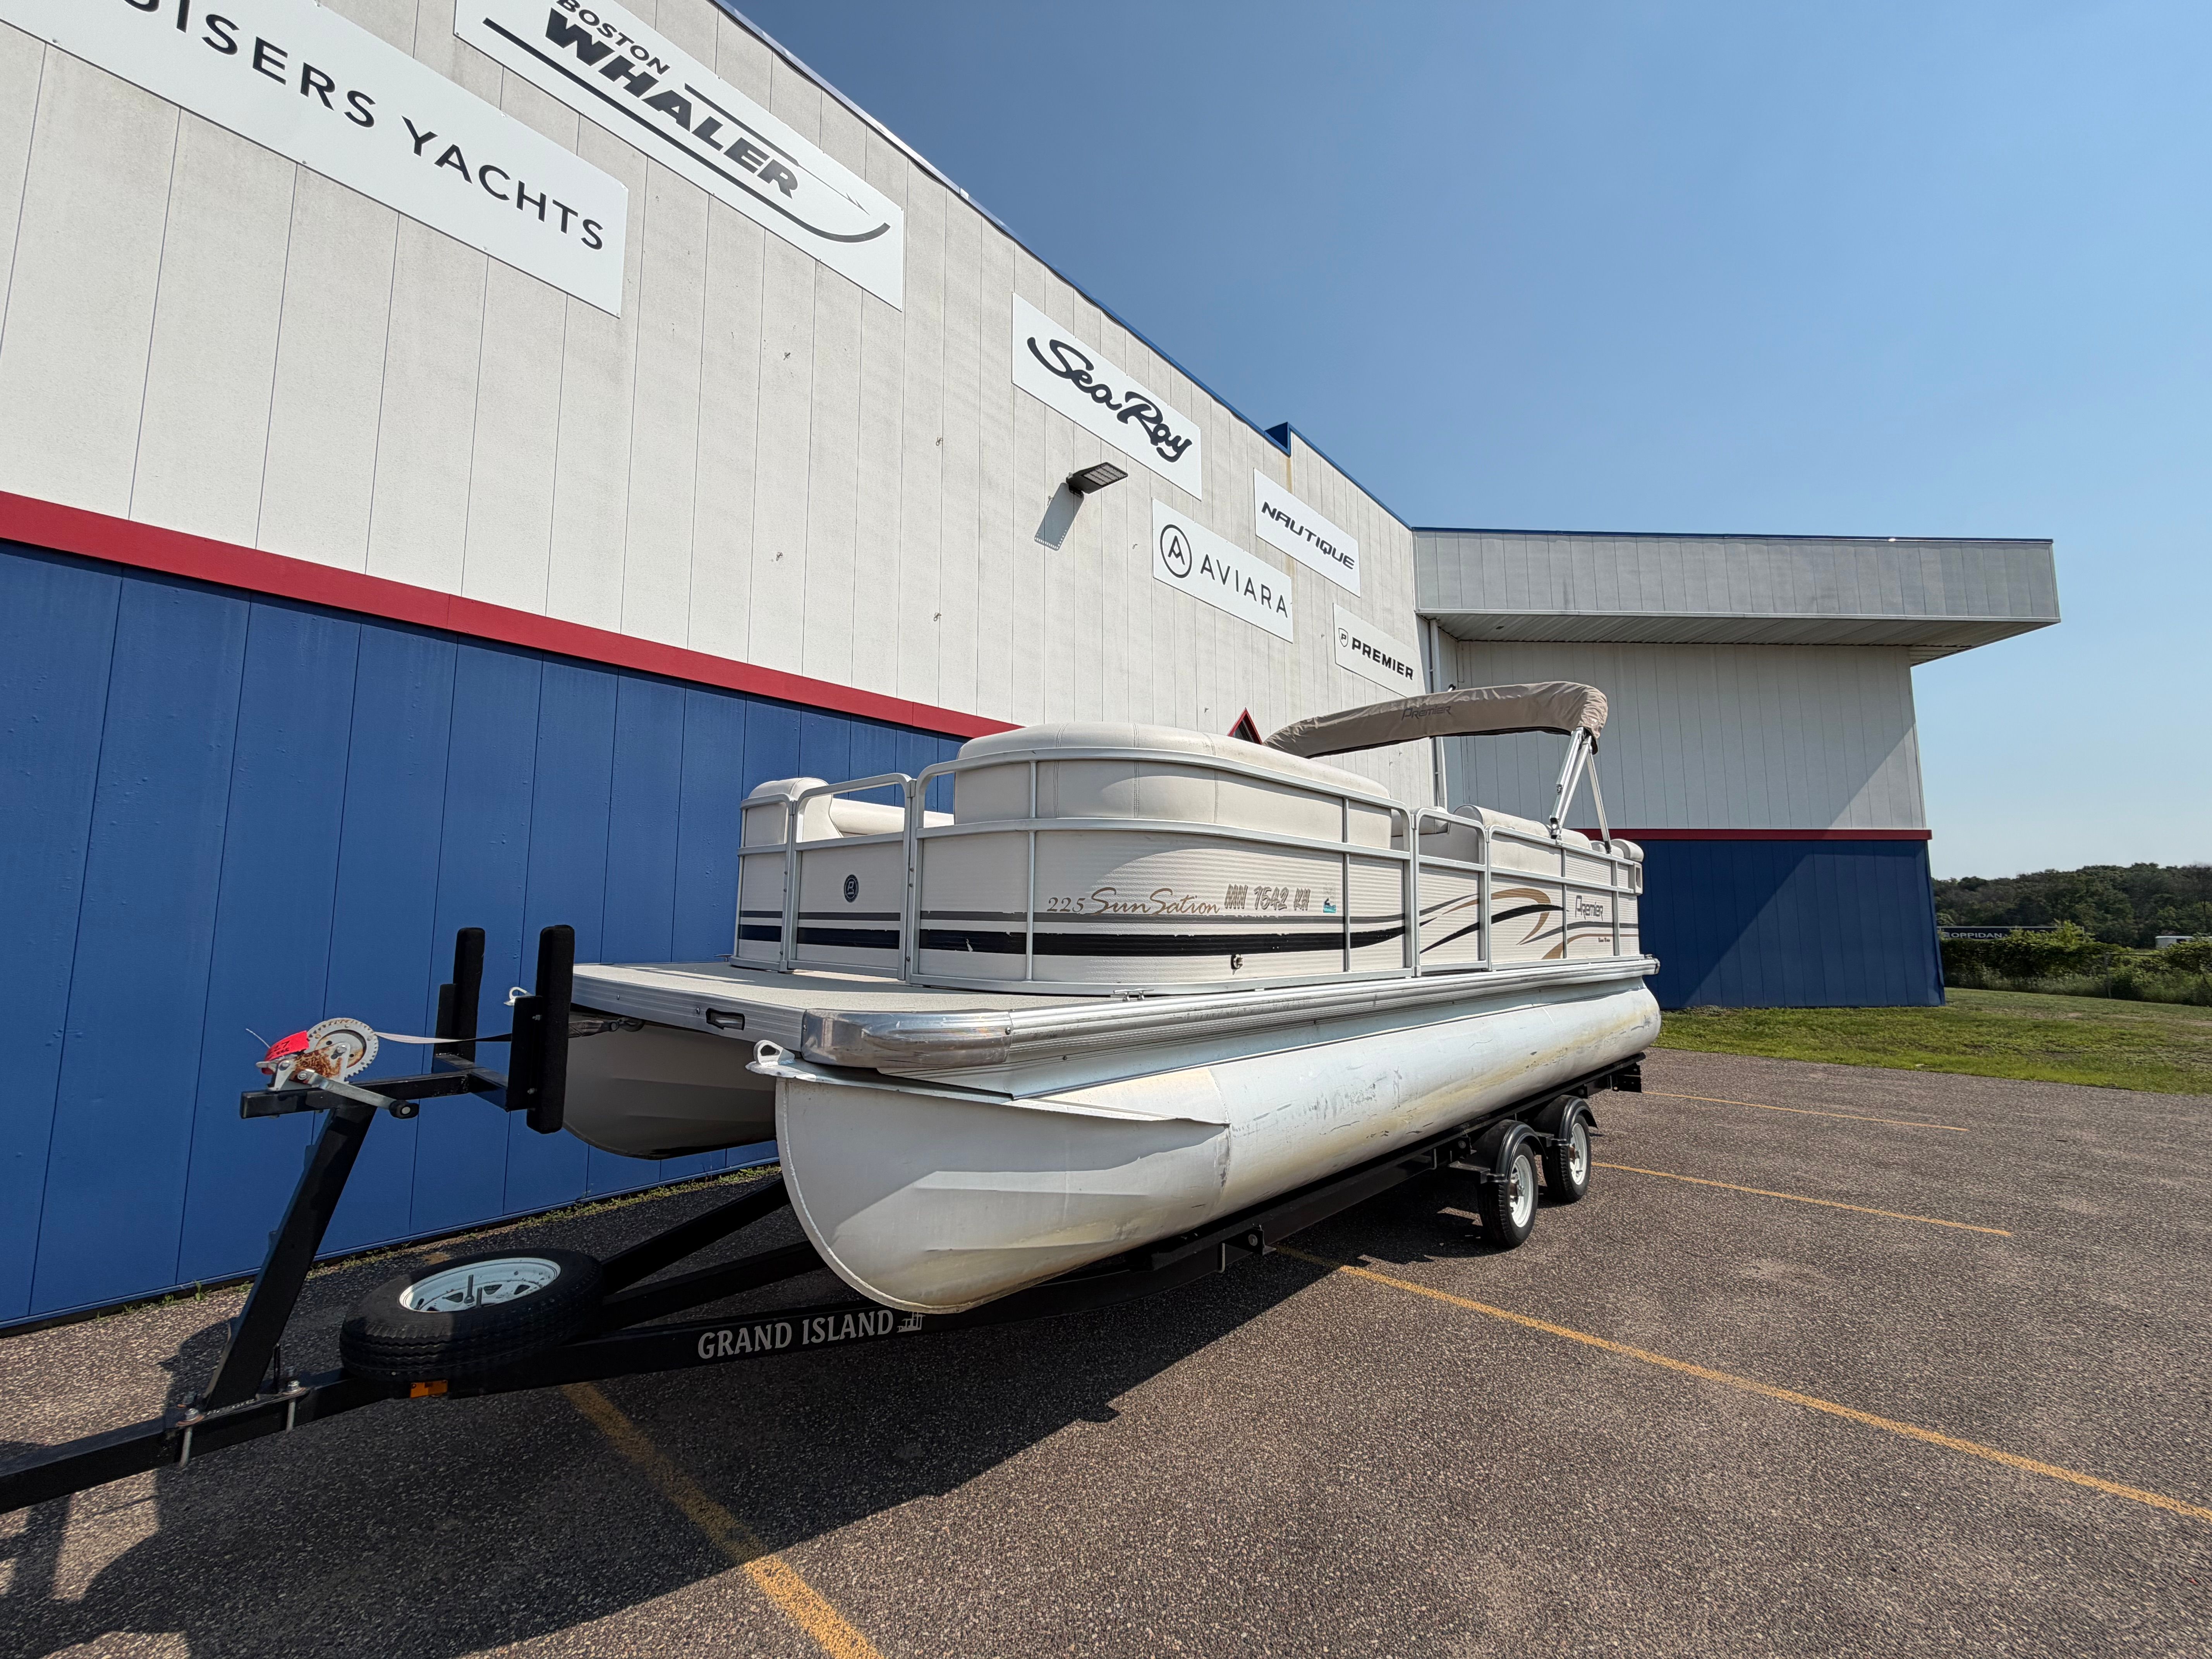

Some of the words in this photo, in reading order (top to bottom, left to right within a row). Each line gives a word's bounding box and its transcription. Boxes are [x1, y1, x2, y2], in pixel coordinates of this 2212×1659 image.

[545, 7, 798, 199] WHALER
[401, 116, 603, 251] YACHTS
[1027, 337, 1123, 411] Sea
[1117, 391, 1193, 462] Ray
[1261, 501, 1355, 570] NAUTIQUE
[1200, 554, 1288, 618] AVIARA
[1352, 637, 1413, 681] PREMIER
[1046, 897, 1086, 912] 225
[1224, 884, 1249, 909] MN
[698, 1322, 792, 1359] GRAND
[802, 1309, 894, 1345] ISLAND
